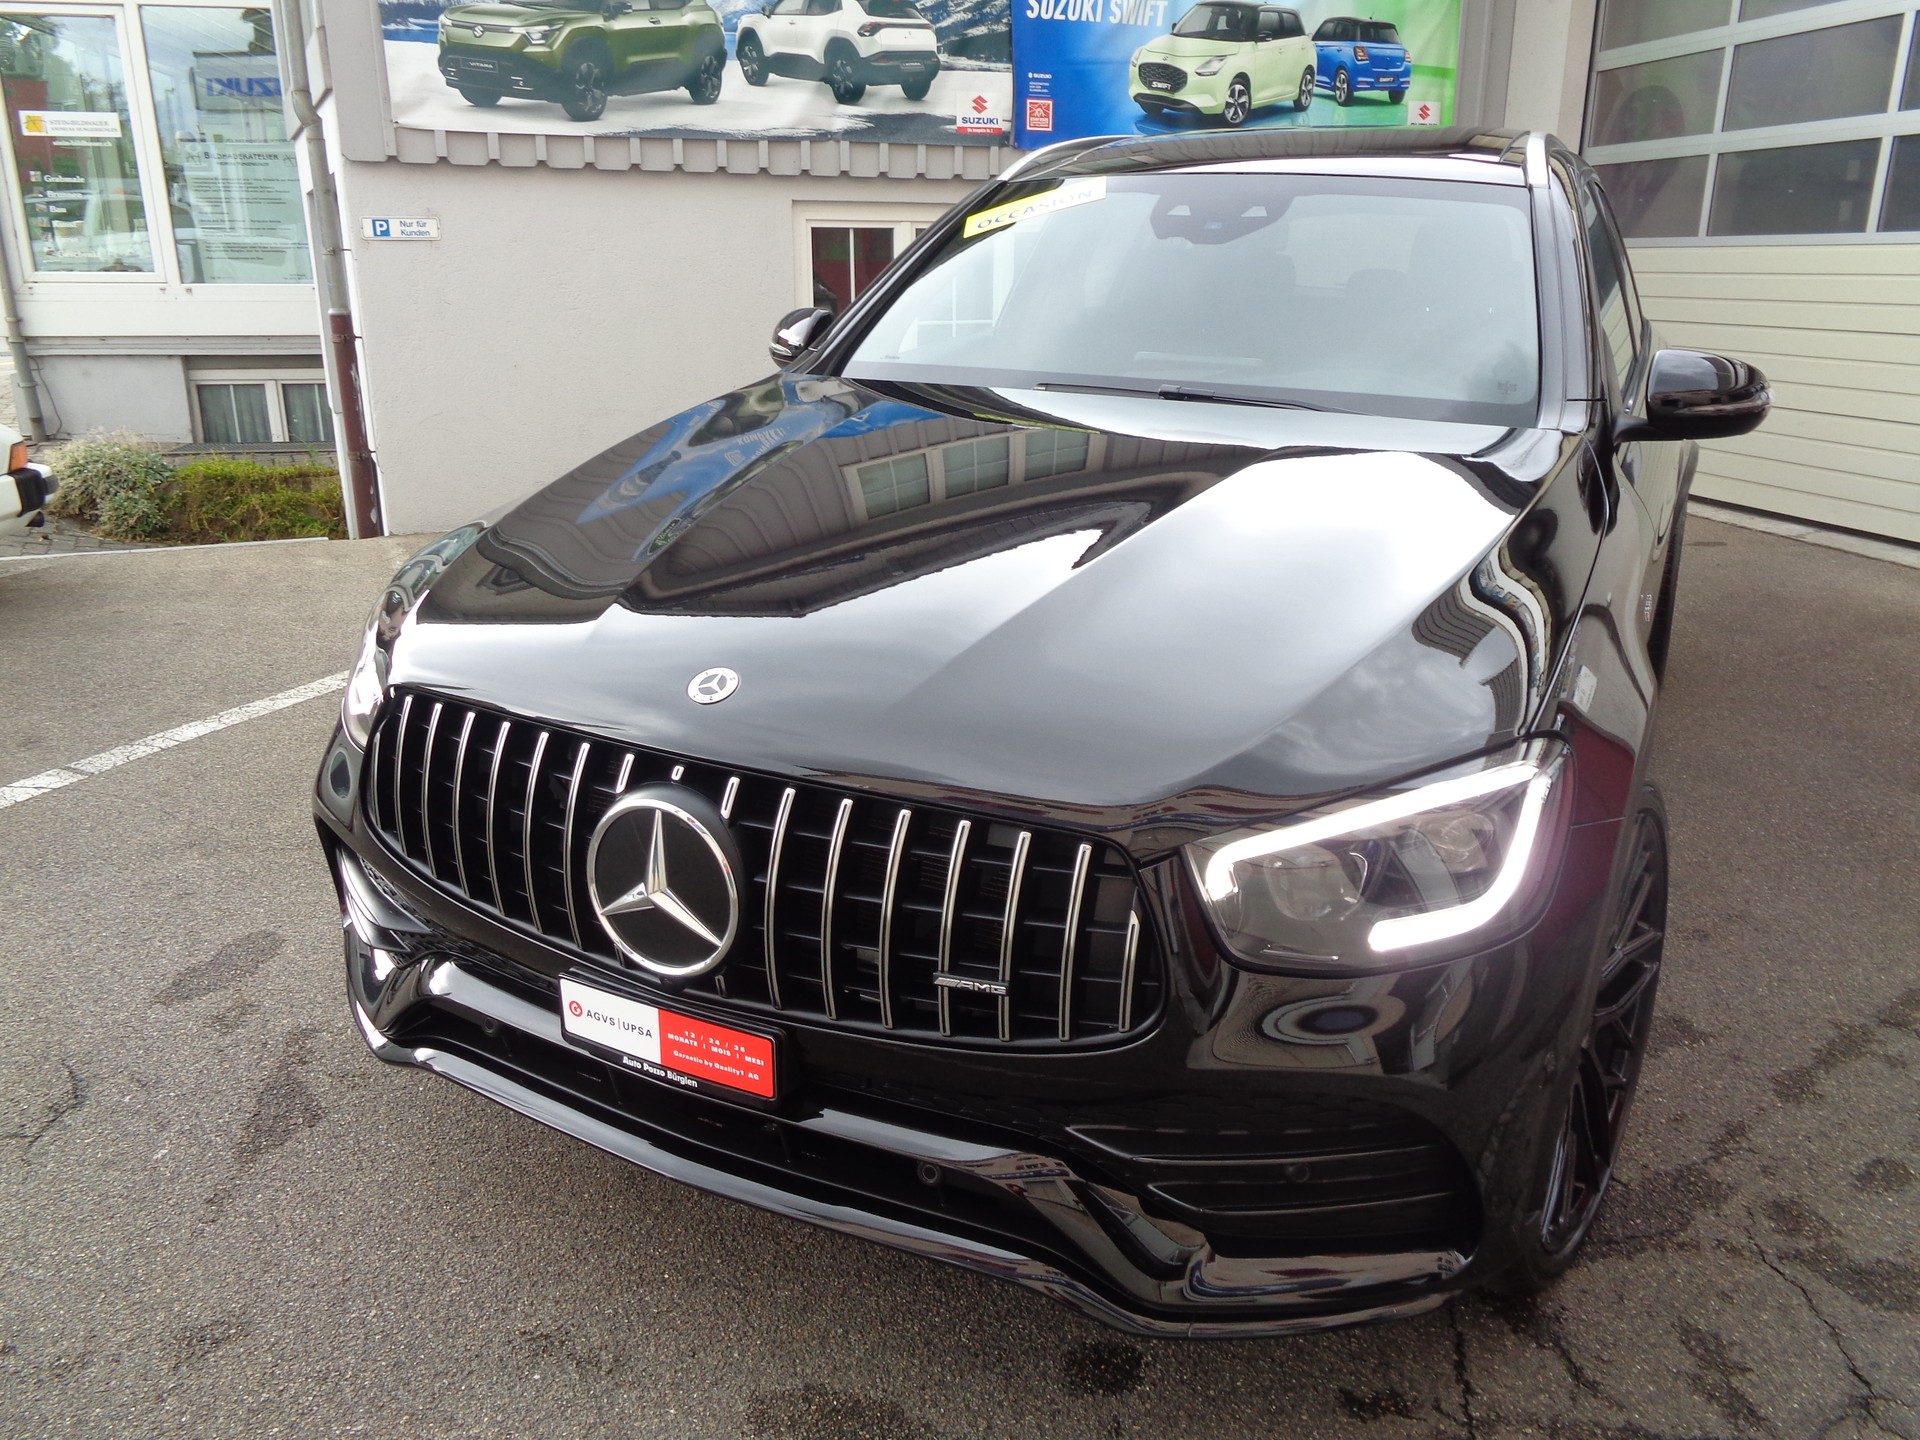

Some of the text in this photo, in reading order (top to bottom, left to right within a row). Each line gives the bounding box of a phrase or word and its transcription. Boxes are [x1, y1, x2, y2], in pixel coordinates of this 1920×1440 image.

[1026, 0, 1168, 27] SUZUKI SWIFT
[1151, 81, 1171, 90] SWIFT
[961, 116, 999, 125] SUZUKI
[977, 190, 1092, 229] OCCASION
[375, 221, 388, 236] P
[400, 220, 427, 228] Nur für
[400, 229, 431, 237] Kunden
[957, 979, 1007, 996] AMG
[586, 1009, 653, 1039] AGVS UPSA
[667, 1032, 698, 1047] MONATE
[711, 1046, 731, 1057] MOIS
[744, 1055, 765, 1067] MESI
[684, 1030, 696, 1039] 12
[708, 1037, 720, 1046] 24
[733, 1044, 746, 1053] 36
[622, 1056, 698, 1088] Auto Pozzo Bürglen
[673, 1049, 760, 1081] Garantie by Quality1 AG
